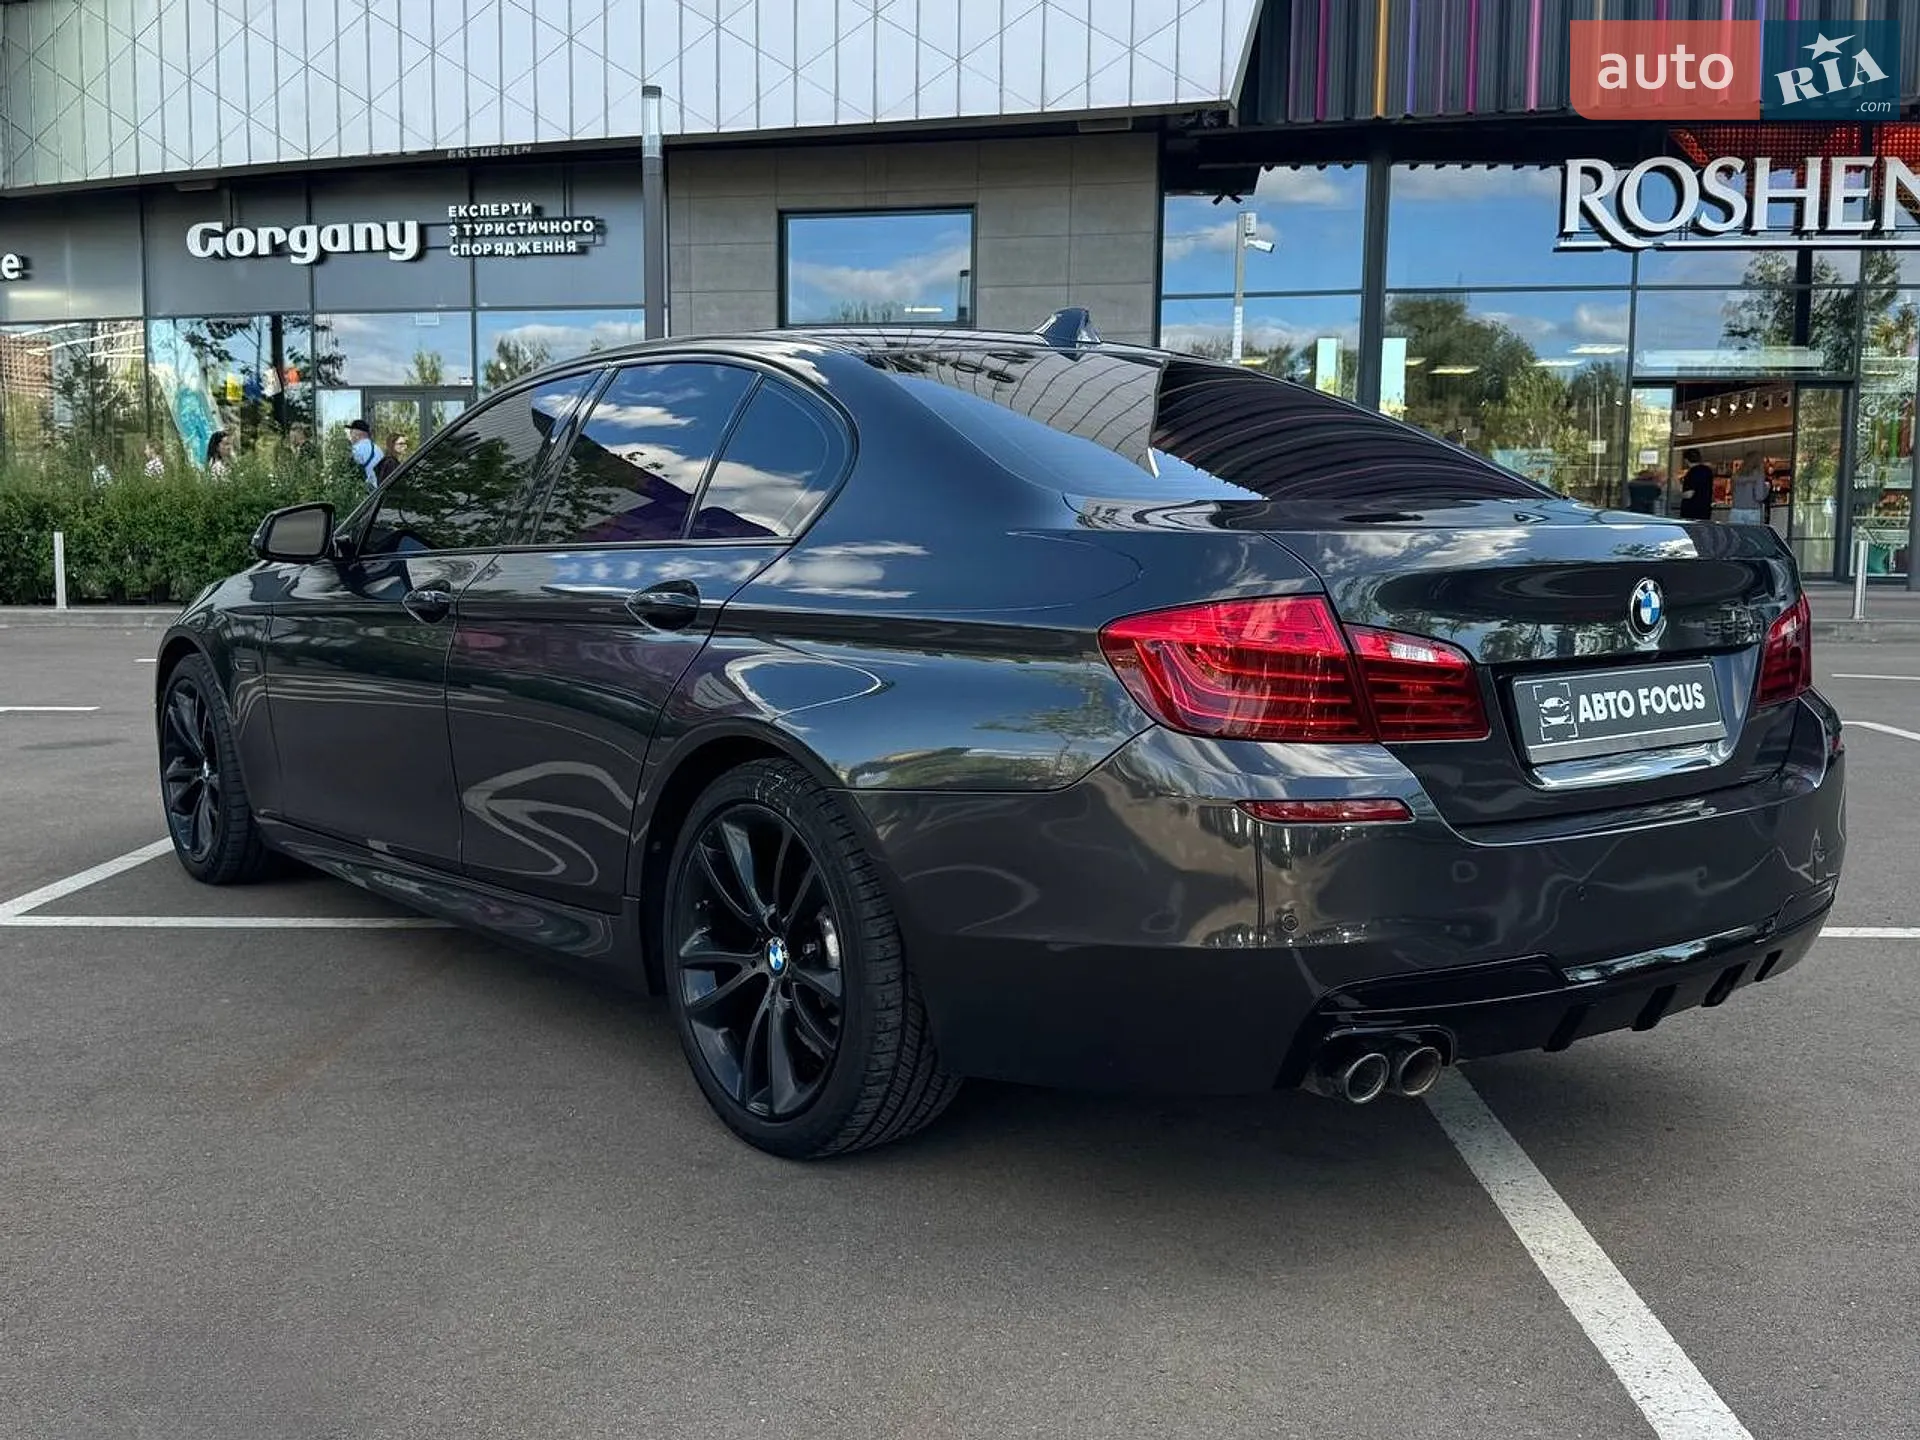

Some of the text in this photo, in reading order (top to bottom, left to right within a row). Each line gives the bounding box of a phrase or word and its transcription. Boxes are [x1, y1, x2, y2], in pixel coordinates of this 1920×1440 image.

[448, 202, 533, 218] ЕКСПЕРТИ
[463, 220, 594, 237] ТУРИСТИЧНОГО
[186, 220, 418, 265] Gorgany
[449, 239, 577, 257] СПОРЯДЖЕННЯ
[1638, 682, 1706, 716] FOCUS
